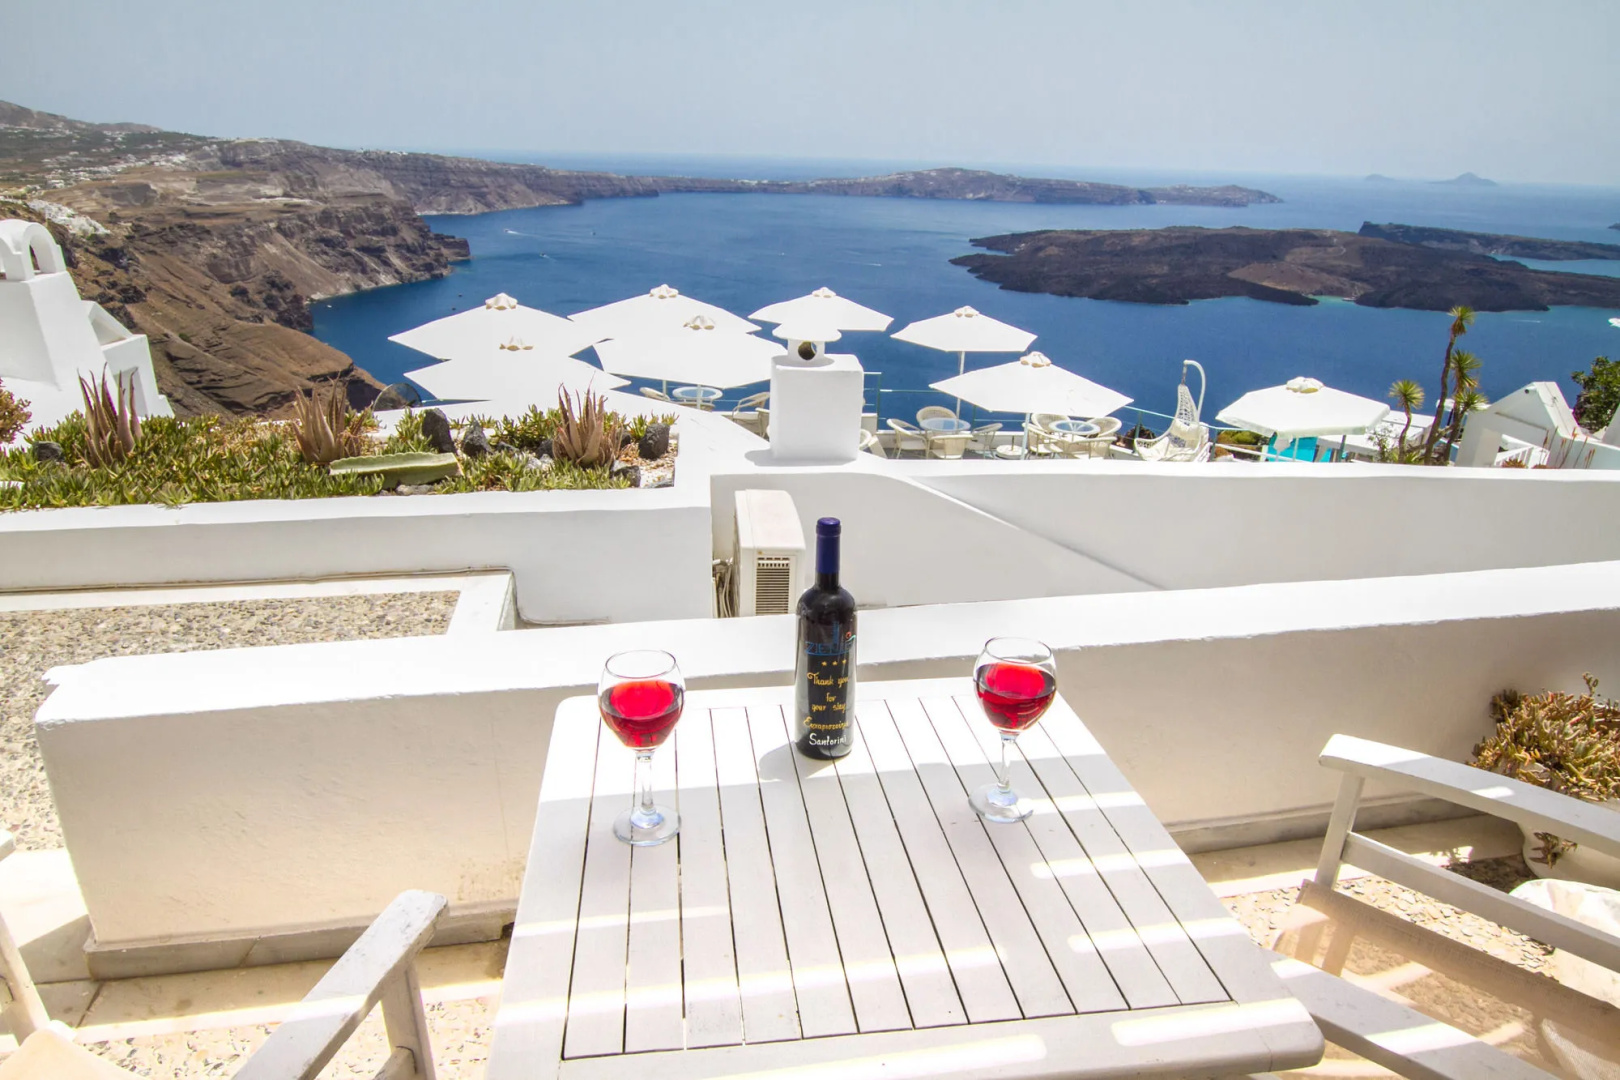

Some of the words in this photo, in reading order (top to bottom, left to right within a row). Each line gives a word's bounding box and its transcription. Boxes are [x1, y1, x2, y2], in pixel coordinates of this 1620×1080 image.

[806, 671, 834, 686] Thank
[825, 692, 836, 703] for
[811, 703, 827, 713] your
[832, 702, 846, 714] stay
[808, 733, 847, 746] Santorini
